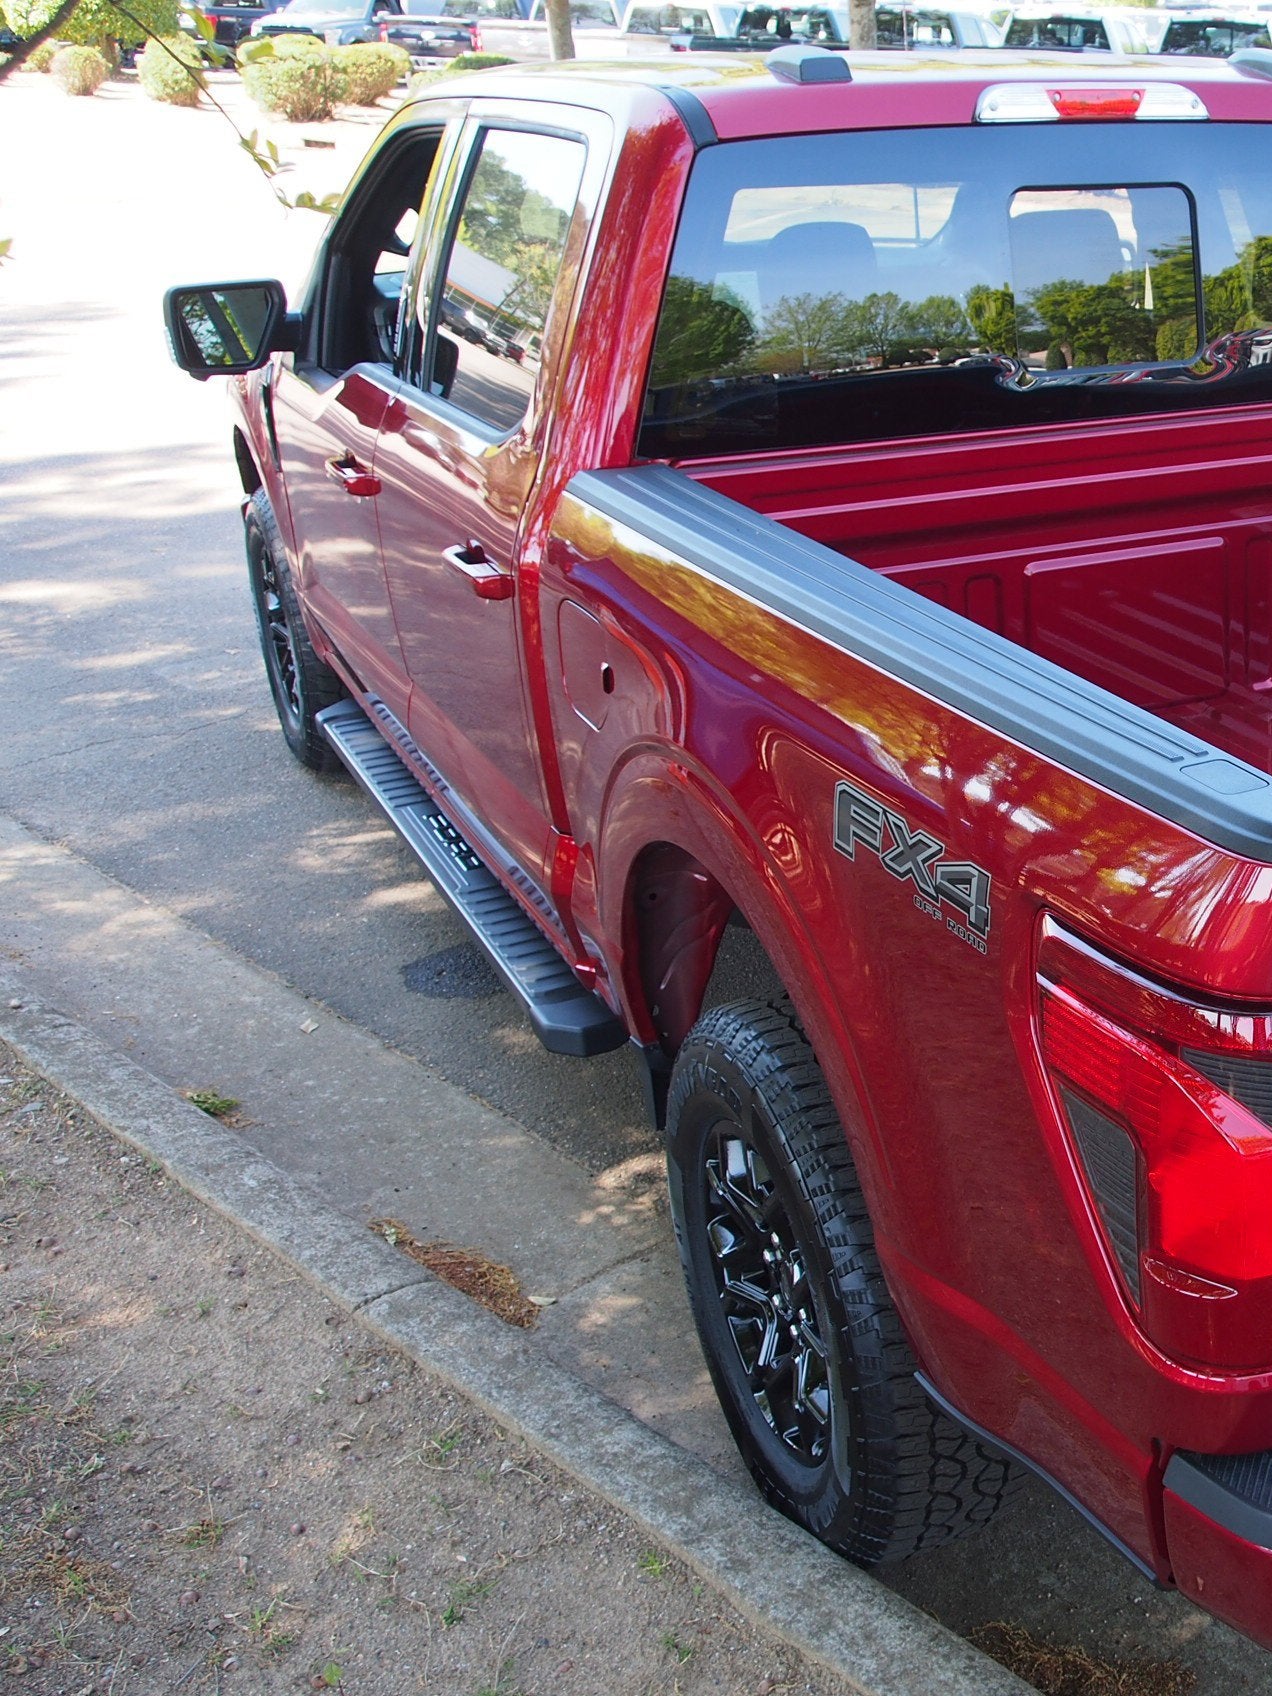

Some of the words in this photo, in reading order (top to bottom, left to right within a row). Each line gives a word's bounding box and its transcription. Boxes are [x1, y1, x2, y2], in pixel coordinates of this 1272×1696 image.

[833, 779, 992, 939] FX4
[913, 894, 942, 921] OFF
[946, 917, 988, 955] ROAD
